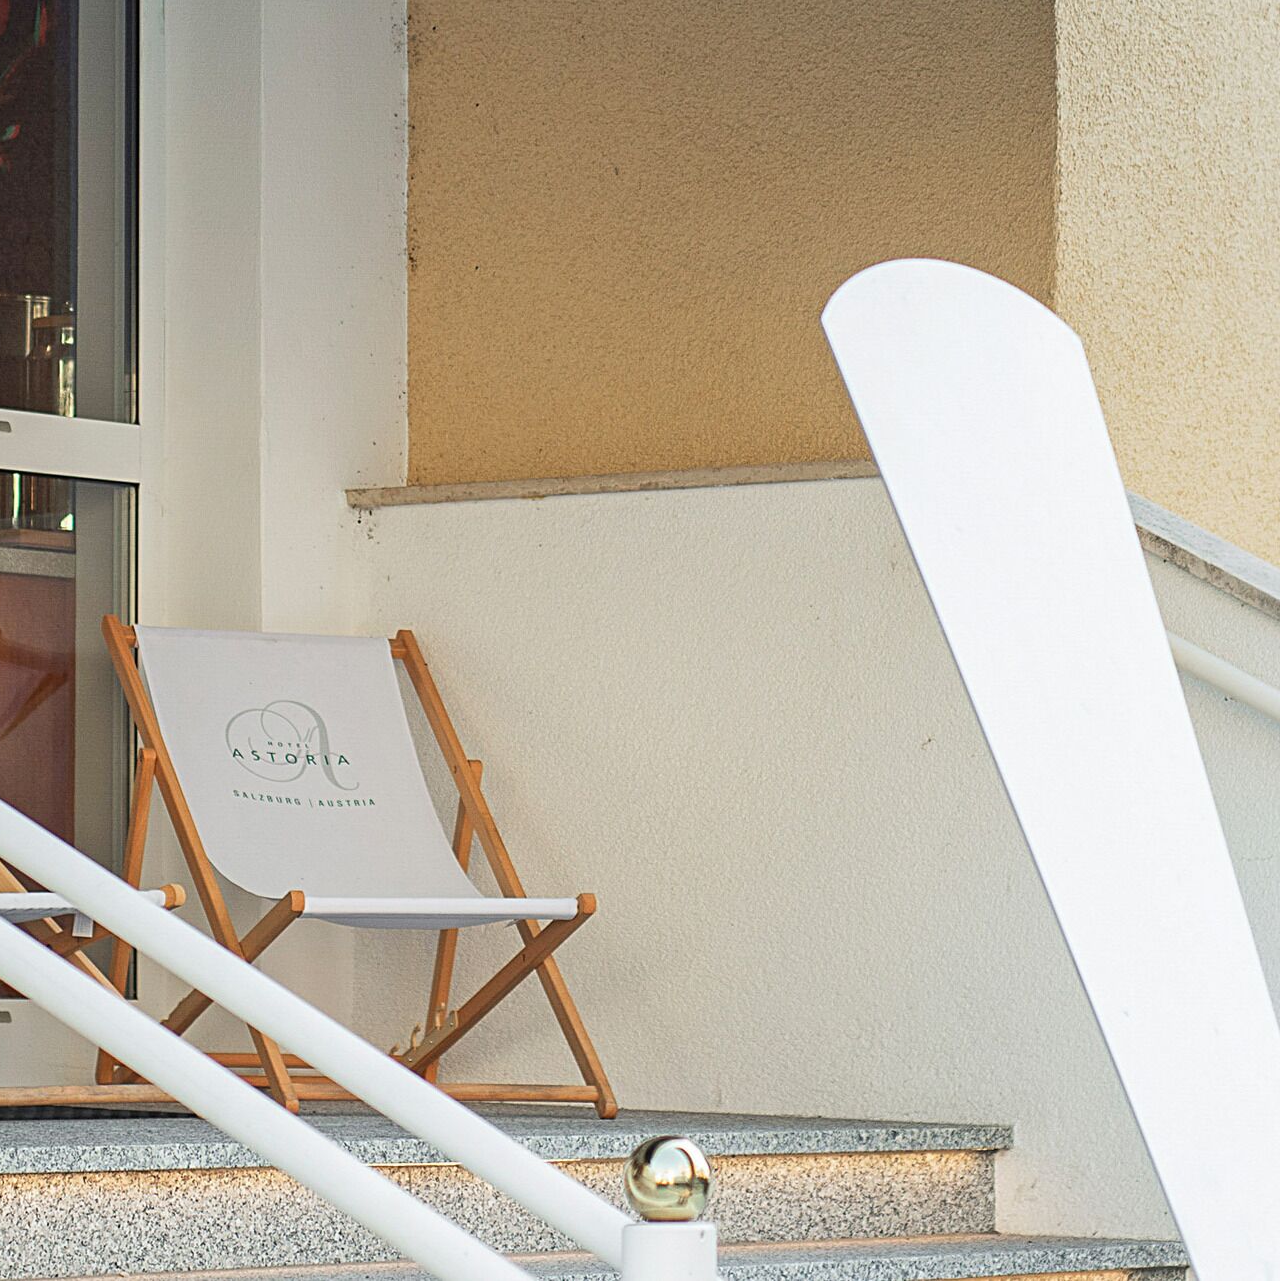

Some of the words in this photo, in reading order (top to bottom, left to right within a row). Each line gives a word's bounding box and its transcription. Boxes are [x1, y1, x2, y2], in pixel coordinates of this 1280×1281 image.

[267, 740, 310, 749] HOTEL
[232, 748, 350, 765] ASTORIA
[233, 789, 302, 806] SALZBURG
[318, 798, 376, 808] AUSTRIA
